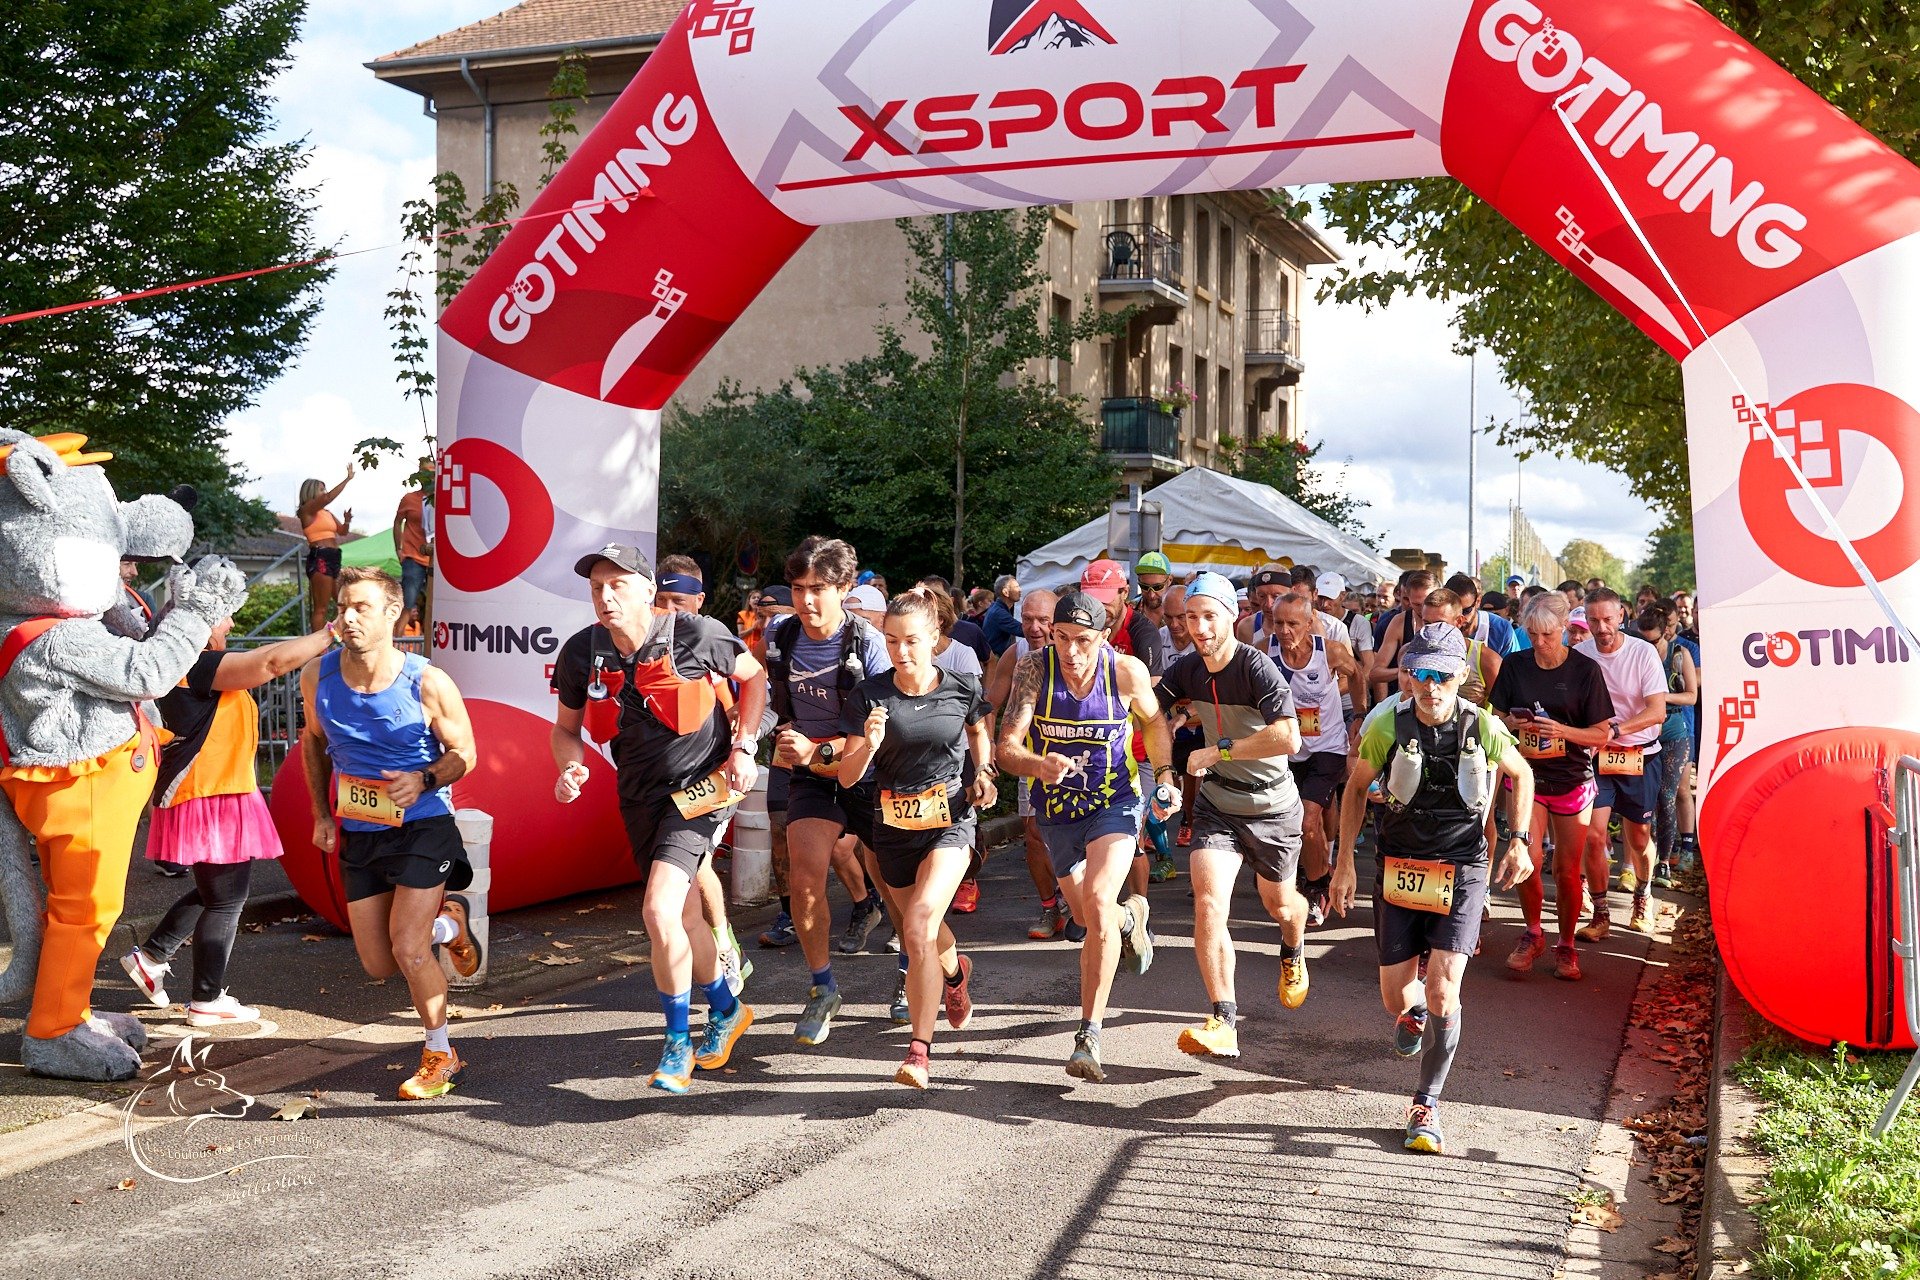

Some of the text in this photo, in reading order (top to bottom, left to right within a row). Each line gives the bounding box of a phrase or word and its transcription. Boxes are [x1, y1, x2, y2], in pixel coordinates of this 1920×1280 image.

[837, 63, 1308, 162] XSPORT
[1478, 0, 1808, 269] GOTIMING
[488, 92, 699, 345] GOTIMING
[797, 682, 828, 700] AIR
[1041, 723, 1094, 738] ROMBAS
[1525, 733, 1538, 747] 59
[1608, 752, 1626, 764] 573
[351, 785, 377, 807] 636
[893, 798, 922, 819] 522
[1397, 870, 1426, 893] 537
